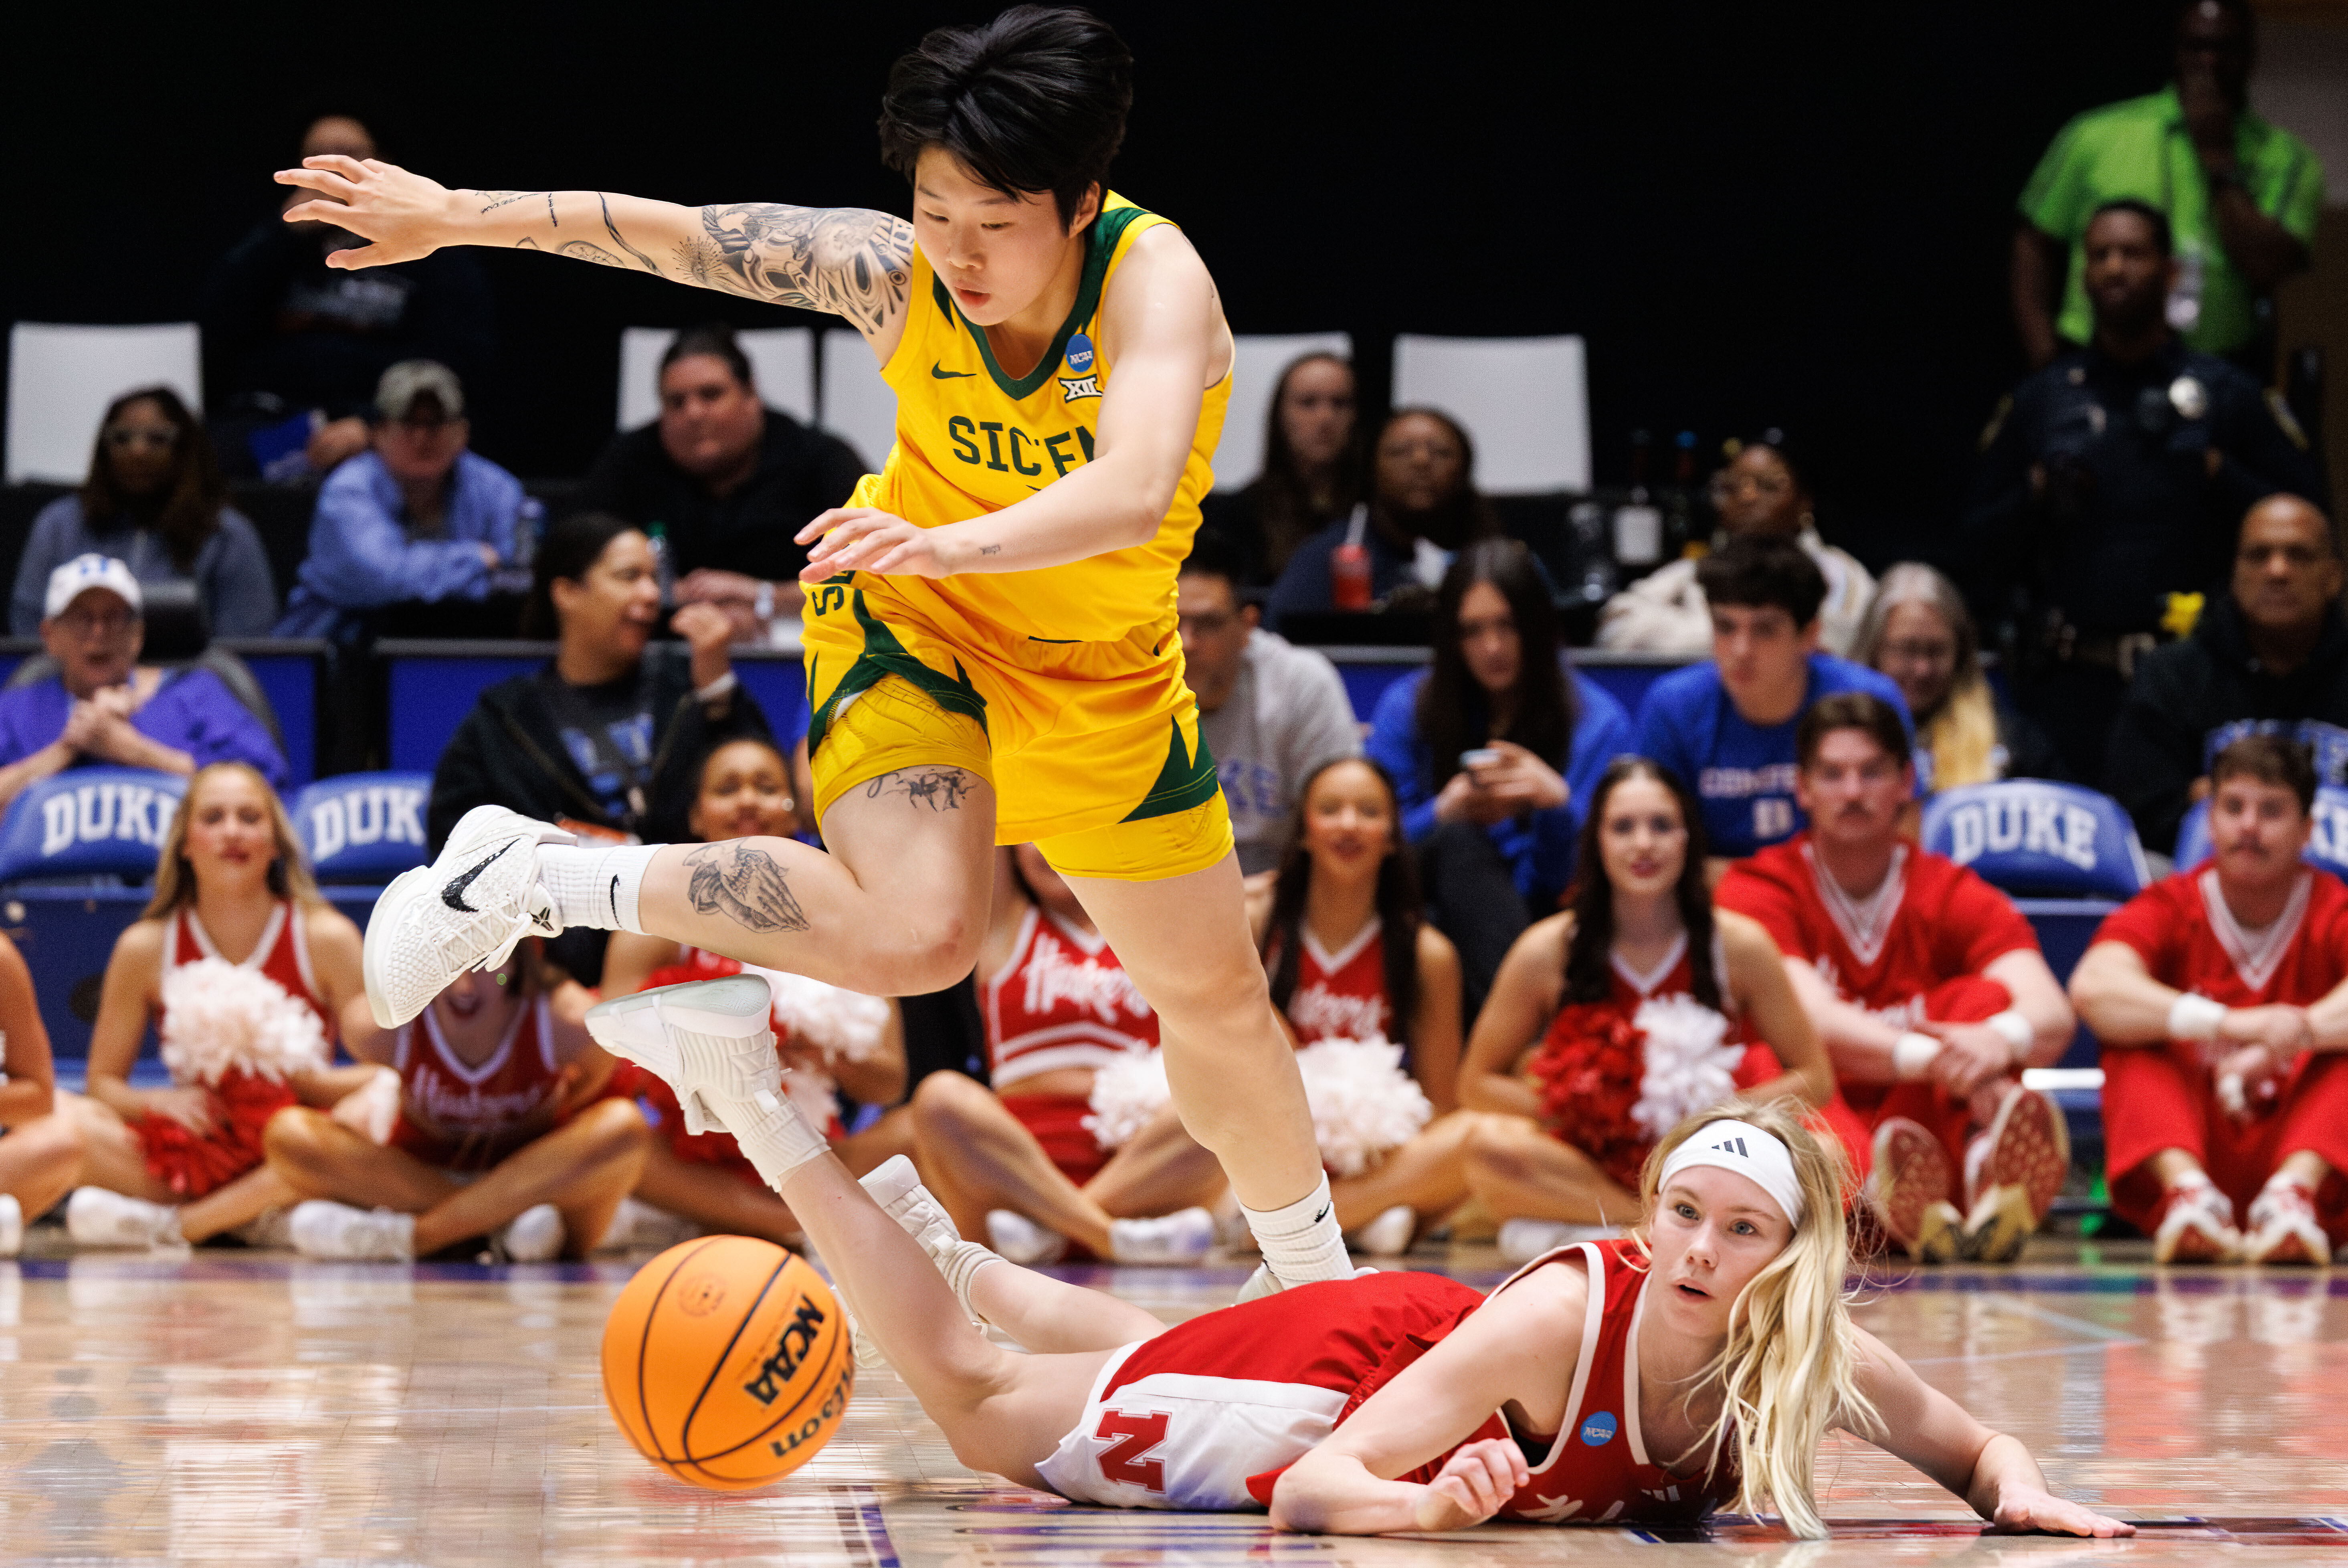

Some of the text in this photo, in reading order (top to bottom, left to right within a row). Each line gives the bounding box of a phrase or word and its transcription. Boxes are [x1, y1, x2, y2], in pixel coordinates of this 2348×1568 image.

[1057, 374, 1103, 403] XII
[1951, 796, 2097, 872] DUKE
[744, 1293, 824, 1405] NCAA
[1093, 1408, 1172, 1494] N
